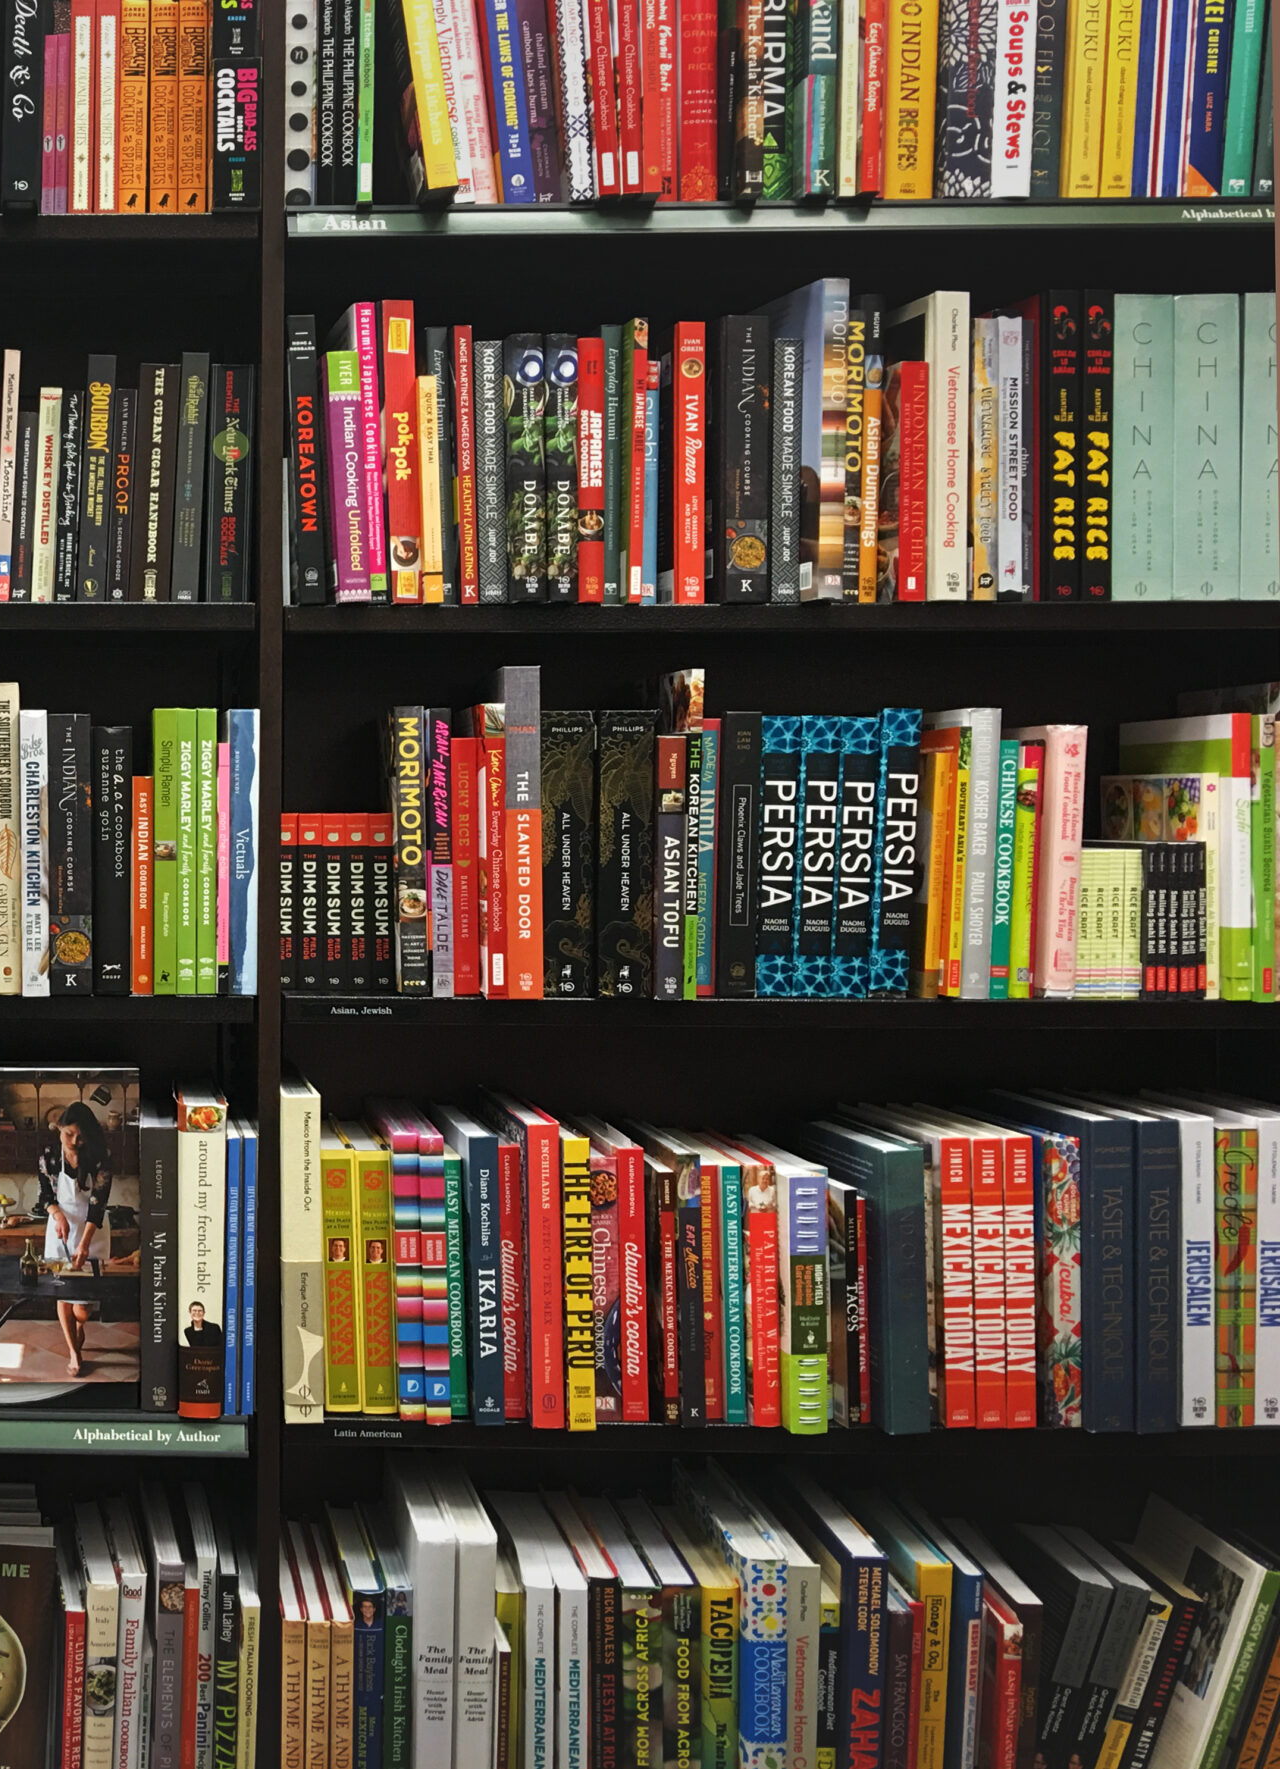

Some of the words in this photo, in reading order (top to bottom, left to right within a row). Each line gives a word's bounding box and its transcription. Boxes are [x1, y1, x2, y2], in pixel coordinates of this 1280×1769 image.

[323, 37, 334, 52] THE
[901, 18, 921, 102] INDIAN
[1006, 11, 1029, 77] Soups
[237, 68, 258, 102] BIG
[321, 54, 334, 111] PHILIPPINE
[1008, 81, 1026, 95] &
[217, 69, 235, 152] COCKTAILS
[243, 104, 258, 151] BAD-ASS
[1005, 100, 1026, 159] Stews
[321, 112, 333, 167] COOKBOOK
[897, 109, 919, 172] RECIPES
[322, 216, 386, 230] Asian
[1182, 209, 1264, 220] Alphabetical
[88, 382, 111, 453] BOURBON
[685, 394, 698, 432] IVAN
[844, 320, 864, 474] MORIMOTO
[343, 407, 355, 446] Indian
[581, 410, 589, 440] SOUL
[590, 411, 602, 488] JAPANESE
[868, 416, 880, 457] Asian
[43, 434, 53, 480] WHISKEY
[296, 396, 317, 532] KOREATOWN
[345, 450, 359, 506] Cooking
[580, 441, 589, 489] COOKING
[684, 437, 697, 485] Ramen
[1053, 431, 1076, 487] FAT
[115, 454, 130, 515] PROOF
[862, 460, 878, 547] Dumplings
[41, 483, 50, 545] DISTILLED
[523, 480, 538, 555] DONABE
[1053, 498, 1075, 561] RICE
[349, 510, 362, 571] Unfolded
[26, 761, 39, 845] CHARLESTON
[397, 717, 421, 866] MORIMOTO
[516, 771, 528, 803] THE
[236, 829, 250, 881] Victuals
[517, 813, 530, 895] SLANTED
[762, 780, 795, 909] PERSIA
[882, 774, 919, 902] PERSIA
[27, 849, 40, 906] KITCHEN
[327, 862, 340, 896] DIM
[664, 836, 680, 893] ASIAN
[327, 899, 340, 935] SUM
[518, 899, 531, 940] DOOR
[663, 900, 678, 948] TOFU
[331, 1006, 359, 1016] Asian,
[362, 1006, 392, 1015] Jewish
[198, 1191, 207, 1217] my
[153, 1231, 166, 1255] My
[198, 1215, 212, 1260] french
[943, 1205, 972, 1300] MEXICAN
[153, 1259, 167, 1294] Paris
[197, 1263, 212, 1293] table
[502, 1239, 519, 1314] claudia's
[1186, 1240, 1211, 1328] JERUSALEM
[153, 1297, 167, 1343] Kitchen
[479, 1268, 497, 1359] IKARIA
[945, 1304, 974, 1374] TODAY
[503, 1317, 519, 1373] cocina
[73, 1430, 153, 1442] Alphabetical
[157, 1431, 172, 1444] by
[176, 1430, 220, 1442] Author
[334, 1429, 356, 1437] Latin
[359, 1429, 402, 1438] American
[859, 1567, 869, 1604] STEVEN
[872, 1567, 881, 1612] MICHAEL
[221, 1612, 233, 1642] Lahey
[857, 1606, 867, 1631] COOK
[419, 1655, 452, 1666] Family
[423, 1666, 448, 1676] Meal
[426, 1645, 445, 1655] The
[709, 1596, 733, 1698] TACOPEDIA
[869, 1614, 880, 1676] SOLOMONOV
